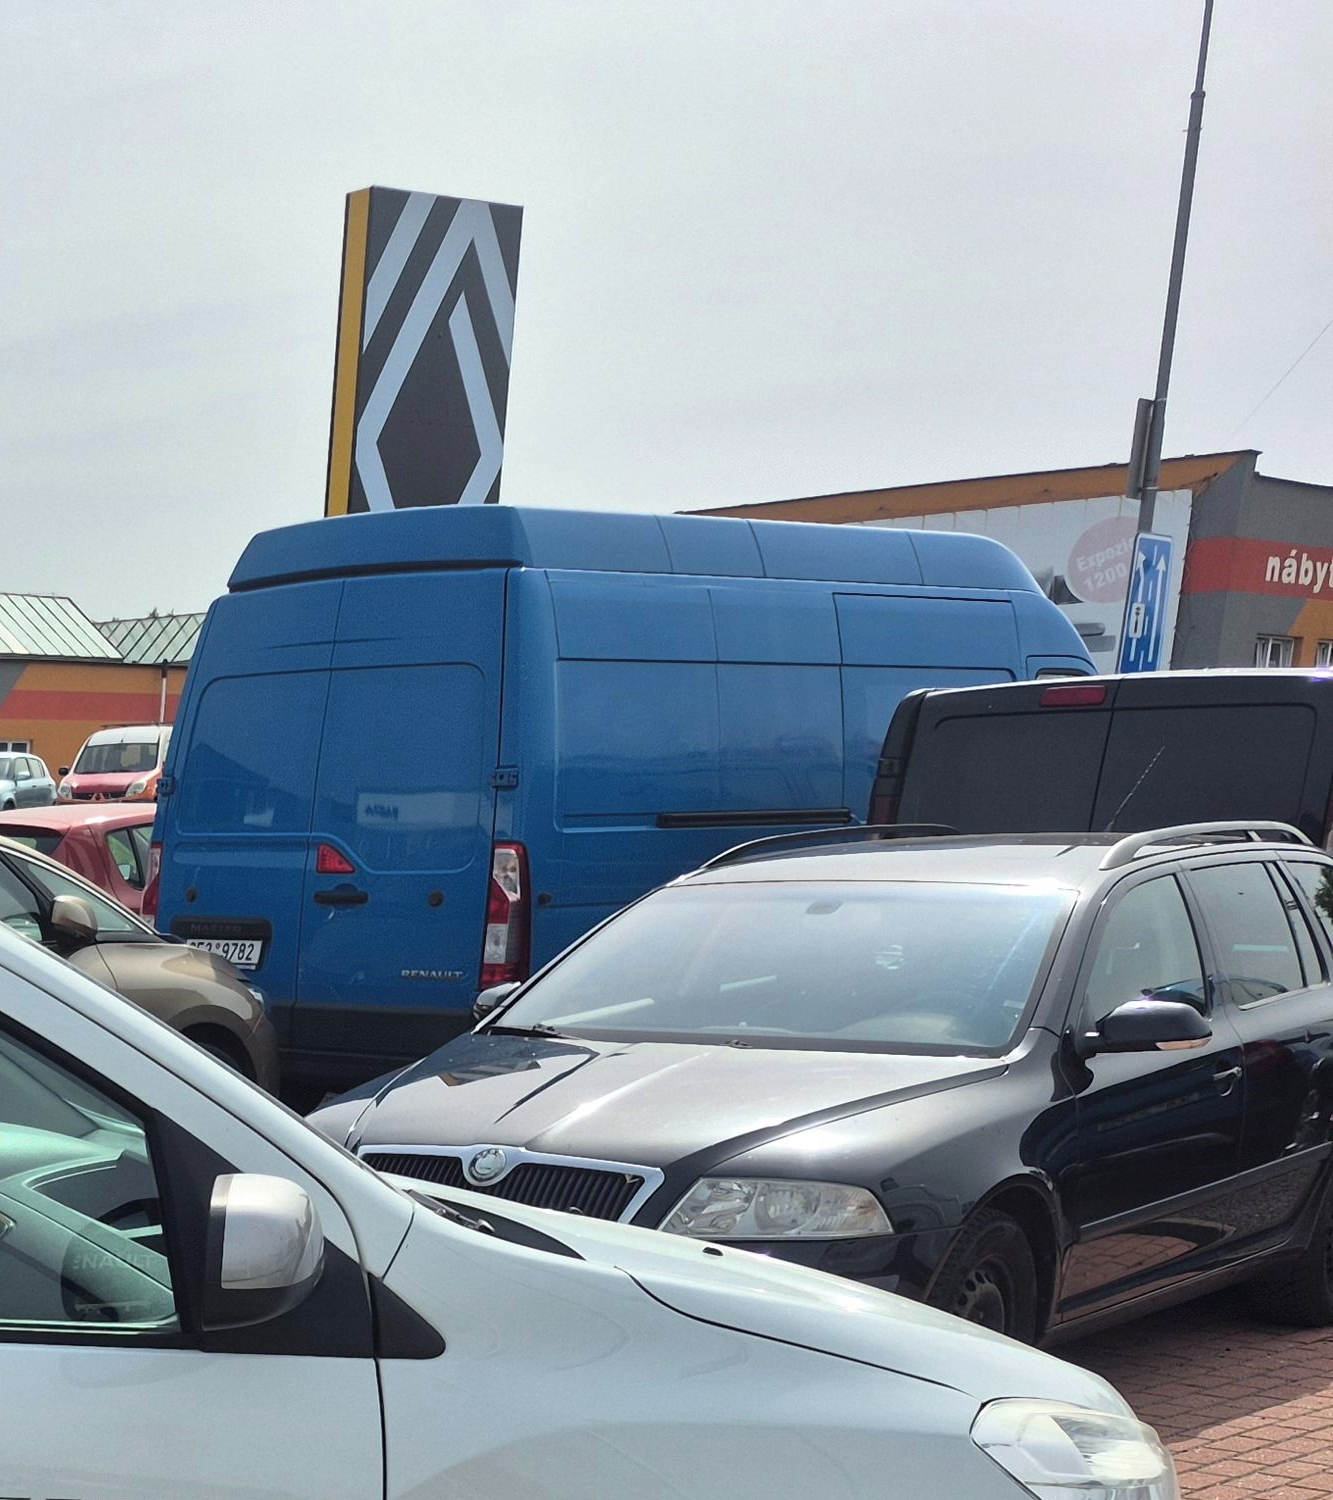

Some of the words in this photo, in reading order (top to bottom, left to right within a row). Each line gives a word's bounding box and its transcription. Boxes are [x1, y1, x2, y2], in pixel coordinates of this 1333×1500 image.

[1084, 562, 1127, 591] 1200
[222, 943, 254, 961] 9782
[401, 969, 463, 980] RENAULT
